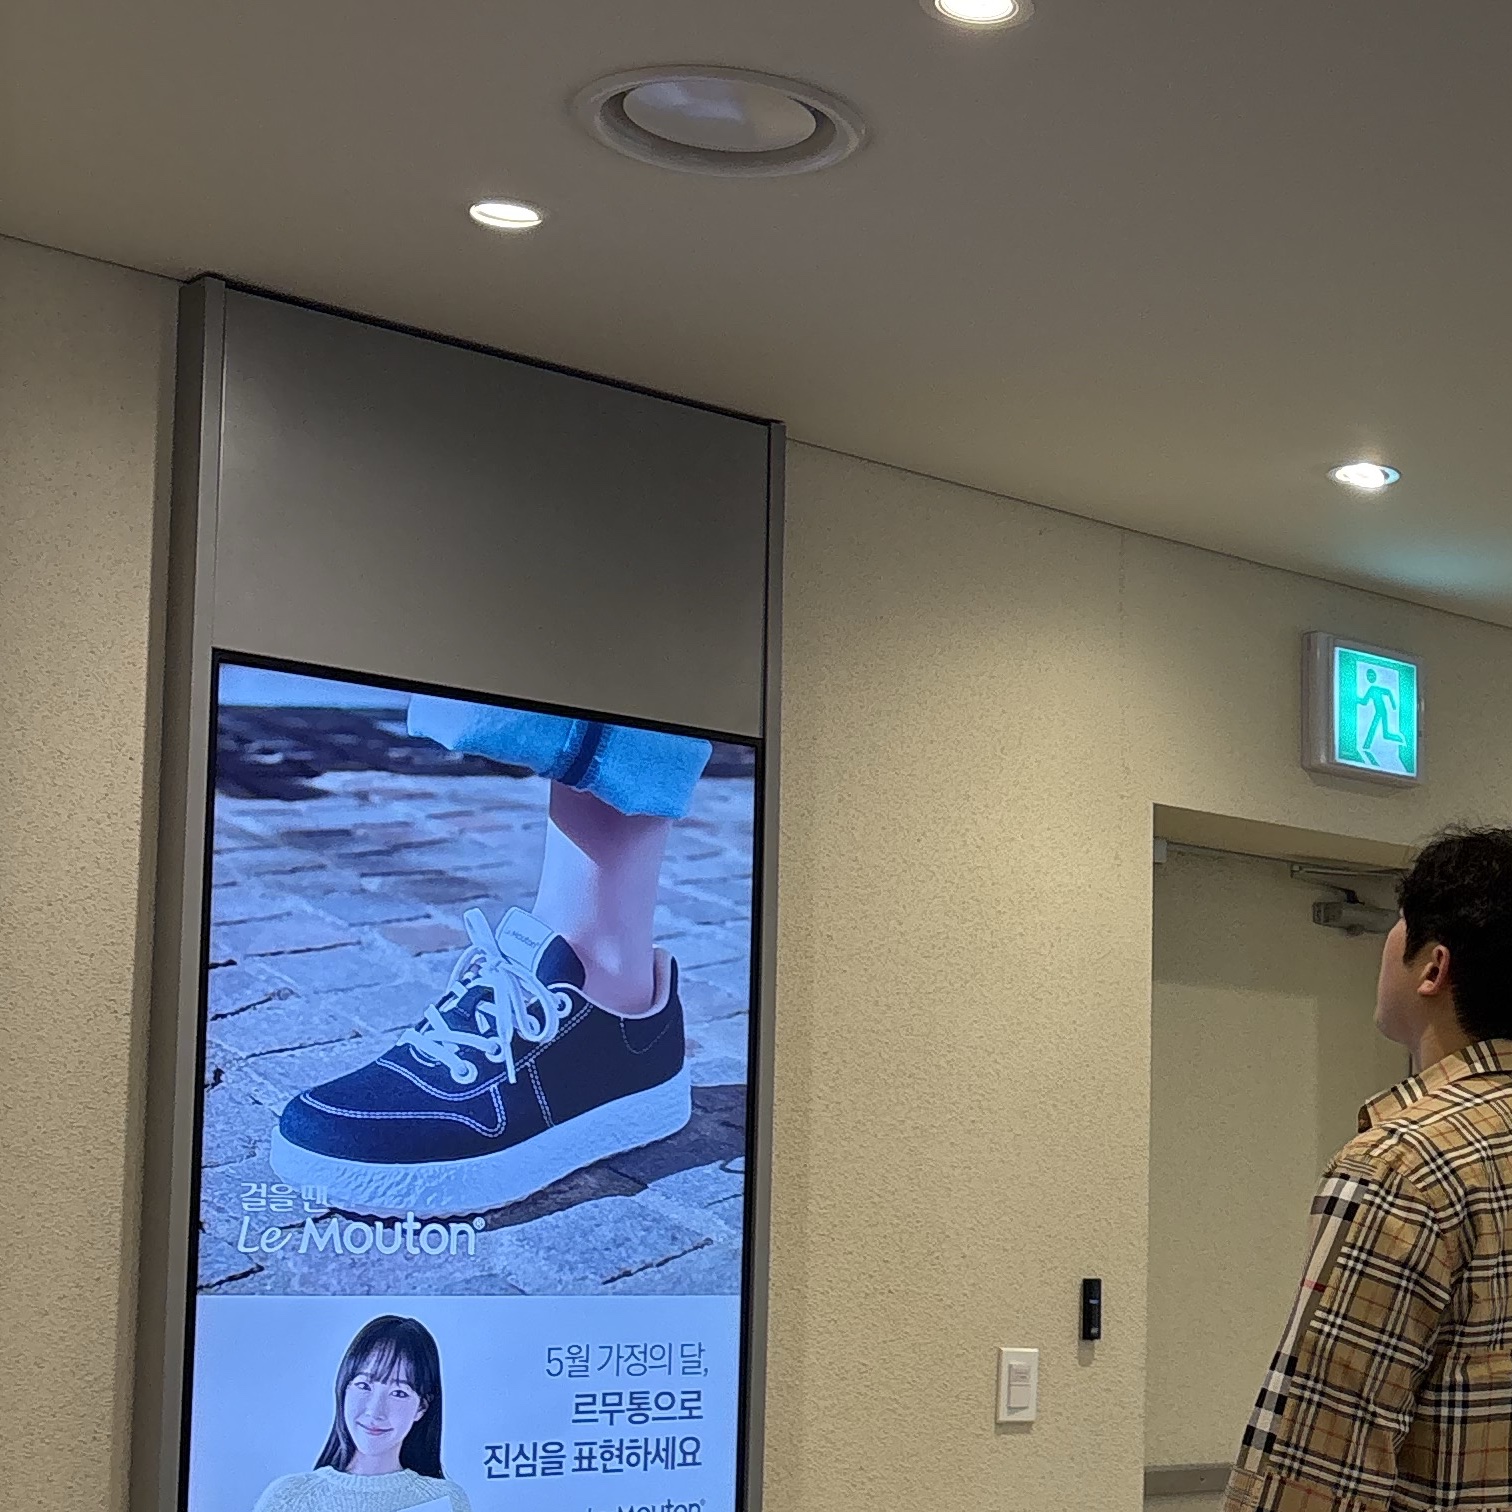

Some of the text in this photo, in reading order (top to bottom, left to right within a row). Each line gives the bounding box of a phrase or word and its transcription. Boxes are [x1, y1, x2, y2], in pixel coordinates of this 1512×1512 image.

[240, 1182, 298, 1212] 걸을
[237, 1216, 292, 1253] Le
[545, 1341, 709, 1378] 5월 가정의 달,
[571, 1390, 704, 1426] 르무통으로
[483, 1436, 702, 1479] 진심을 표현하세요
